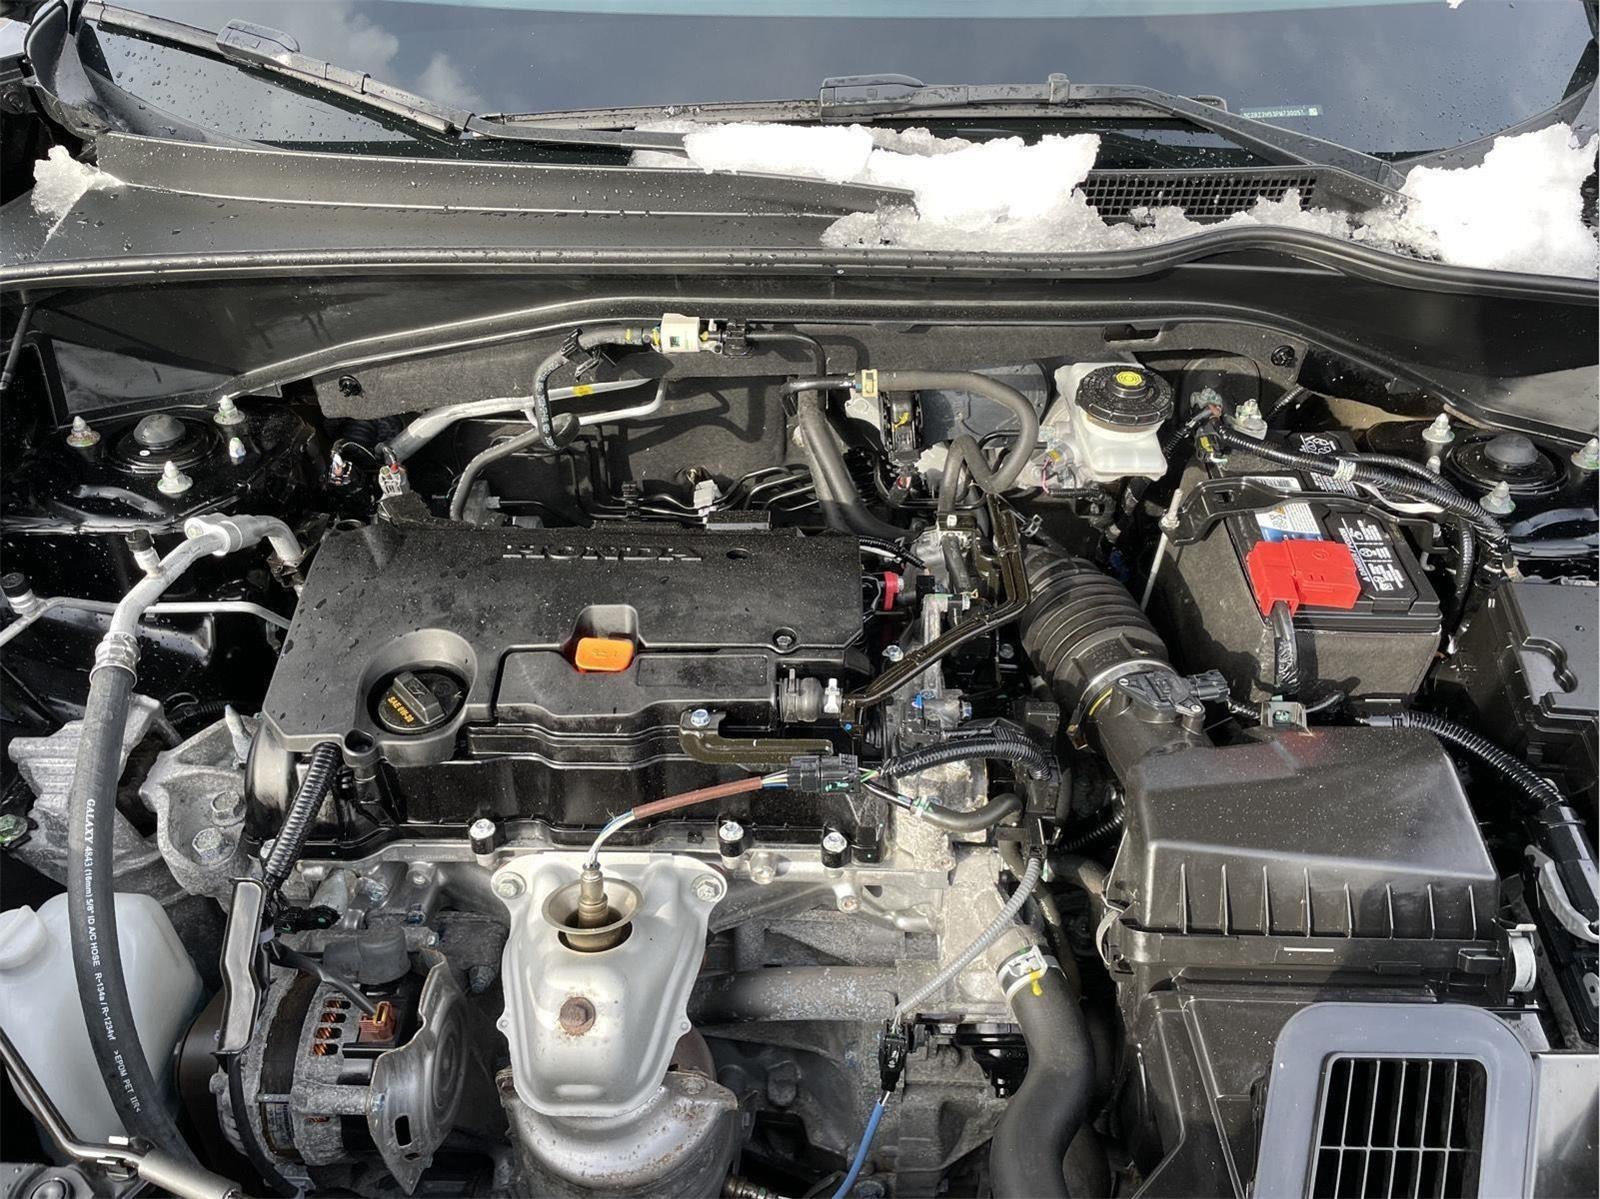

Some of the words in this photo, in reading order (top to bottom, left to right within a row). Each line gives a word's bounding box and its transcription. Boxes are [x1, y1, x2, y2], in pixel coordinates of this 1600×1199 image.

[503, 544, 702, 561] HONDA
[83, 799, 96, 844] GALAXY
[83, 845, 94, 867] 4843
[84, 869, 93, 897] (16mm)
[87, 915, 96, 925] ID
[88, 926, 98, 942] A/C
[90, 942, 101, 967] HOSE
[94, 972, 106, 1001] R-134a
[102, 1007, 116, 1041] R-1234yf
[123, 1079, 135, 1093] PET
